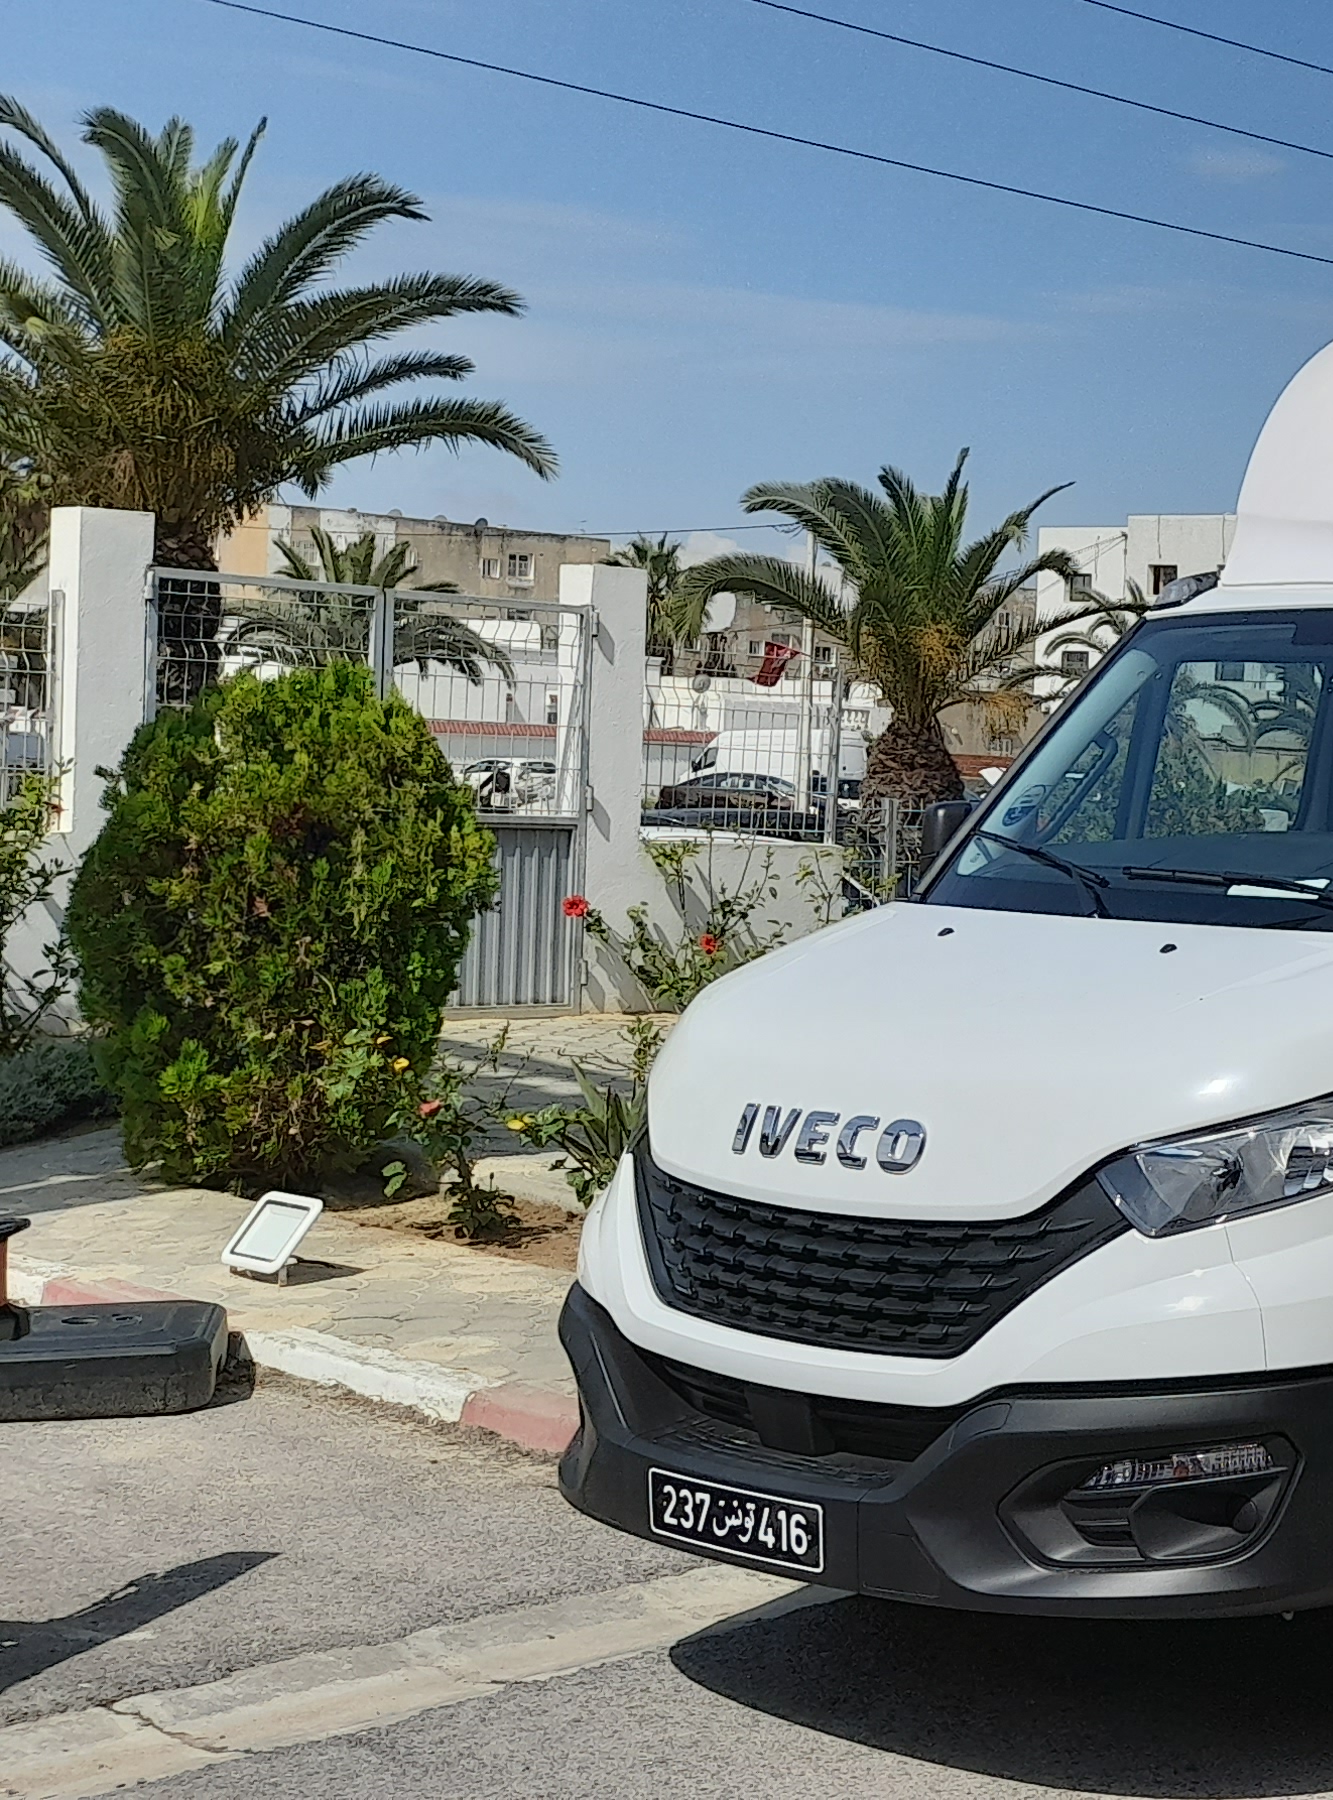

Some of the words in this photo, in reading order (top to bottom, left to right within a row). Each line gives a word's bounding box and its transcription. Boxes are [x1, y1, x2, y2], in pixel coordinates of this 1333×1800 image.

[732, 1102, 928, 1176] IVECO
[662, 1484, 711, 1533] 237
[712, 1499, 756, 1544] تونس
[757, 1506, 809, 1556] 416
